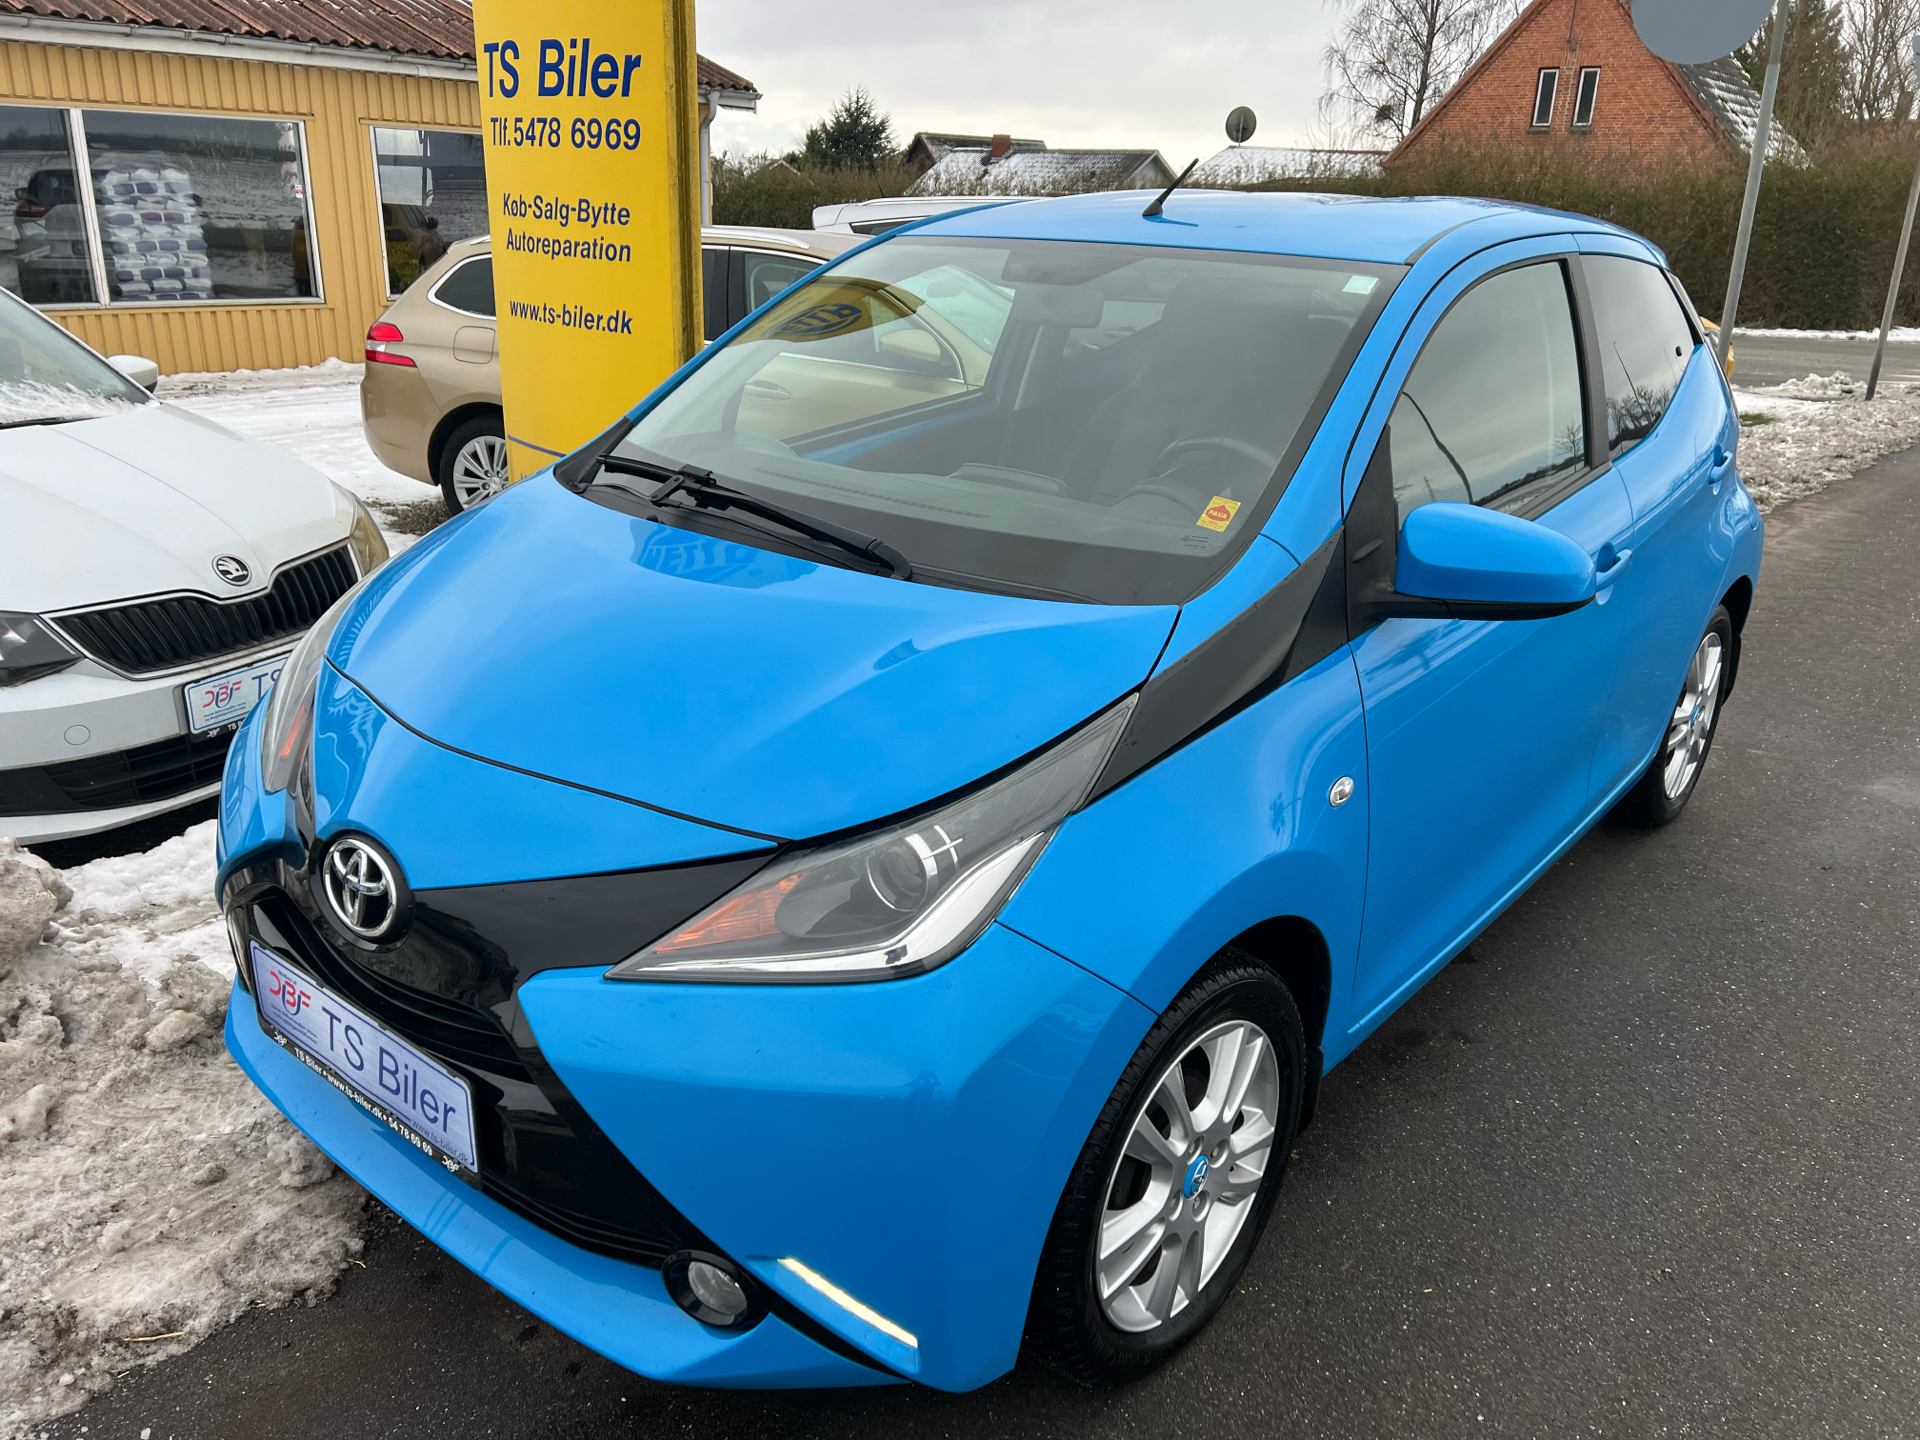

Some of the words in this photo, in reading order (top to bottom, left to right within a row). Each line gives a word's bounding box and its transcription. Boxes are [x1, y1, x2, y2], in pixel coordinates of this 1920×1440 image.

[484, 40, 520, 98] TS
[537, 38, 642, 98] Biler
[570, 118, 641, 150] 6969
[503, 193, 631, 228] Køb-Salg-Bytte
[506, 228, 631, 262] Autoreparation
[509, 300, 632, 335] www.ts-biler.dk
[1208, 509, 1228, 519] PAVA
[322, 1006, 364, 1071] TS
[379, 1046, 456, 1133] Biler
[294, 1047, 305, 1062] TS
[305, 1055, 322, 1074] Biler
[327, 1073, 384, 1121] www.ts-biler.dk
[399, 1124, 410, 1140] 78
[412, 1120, 469, 1165] www.ts-biler.dk
